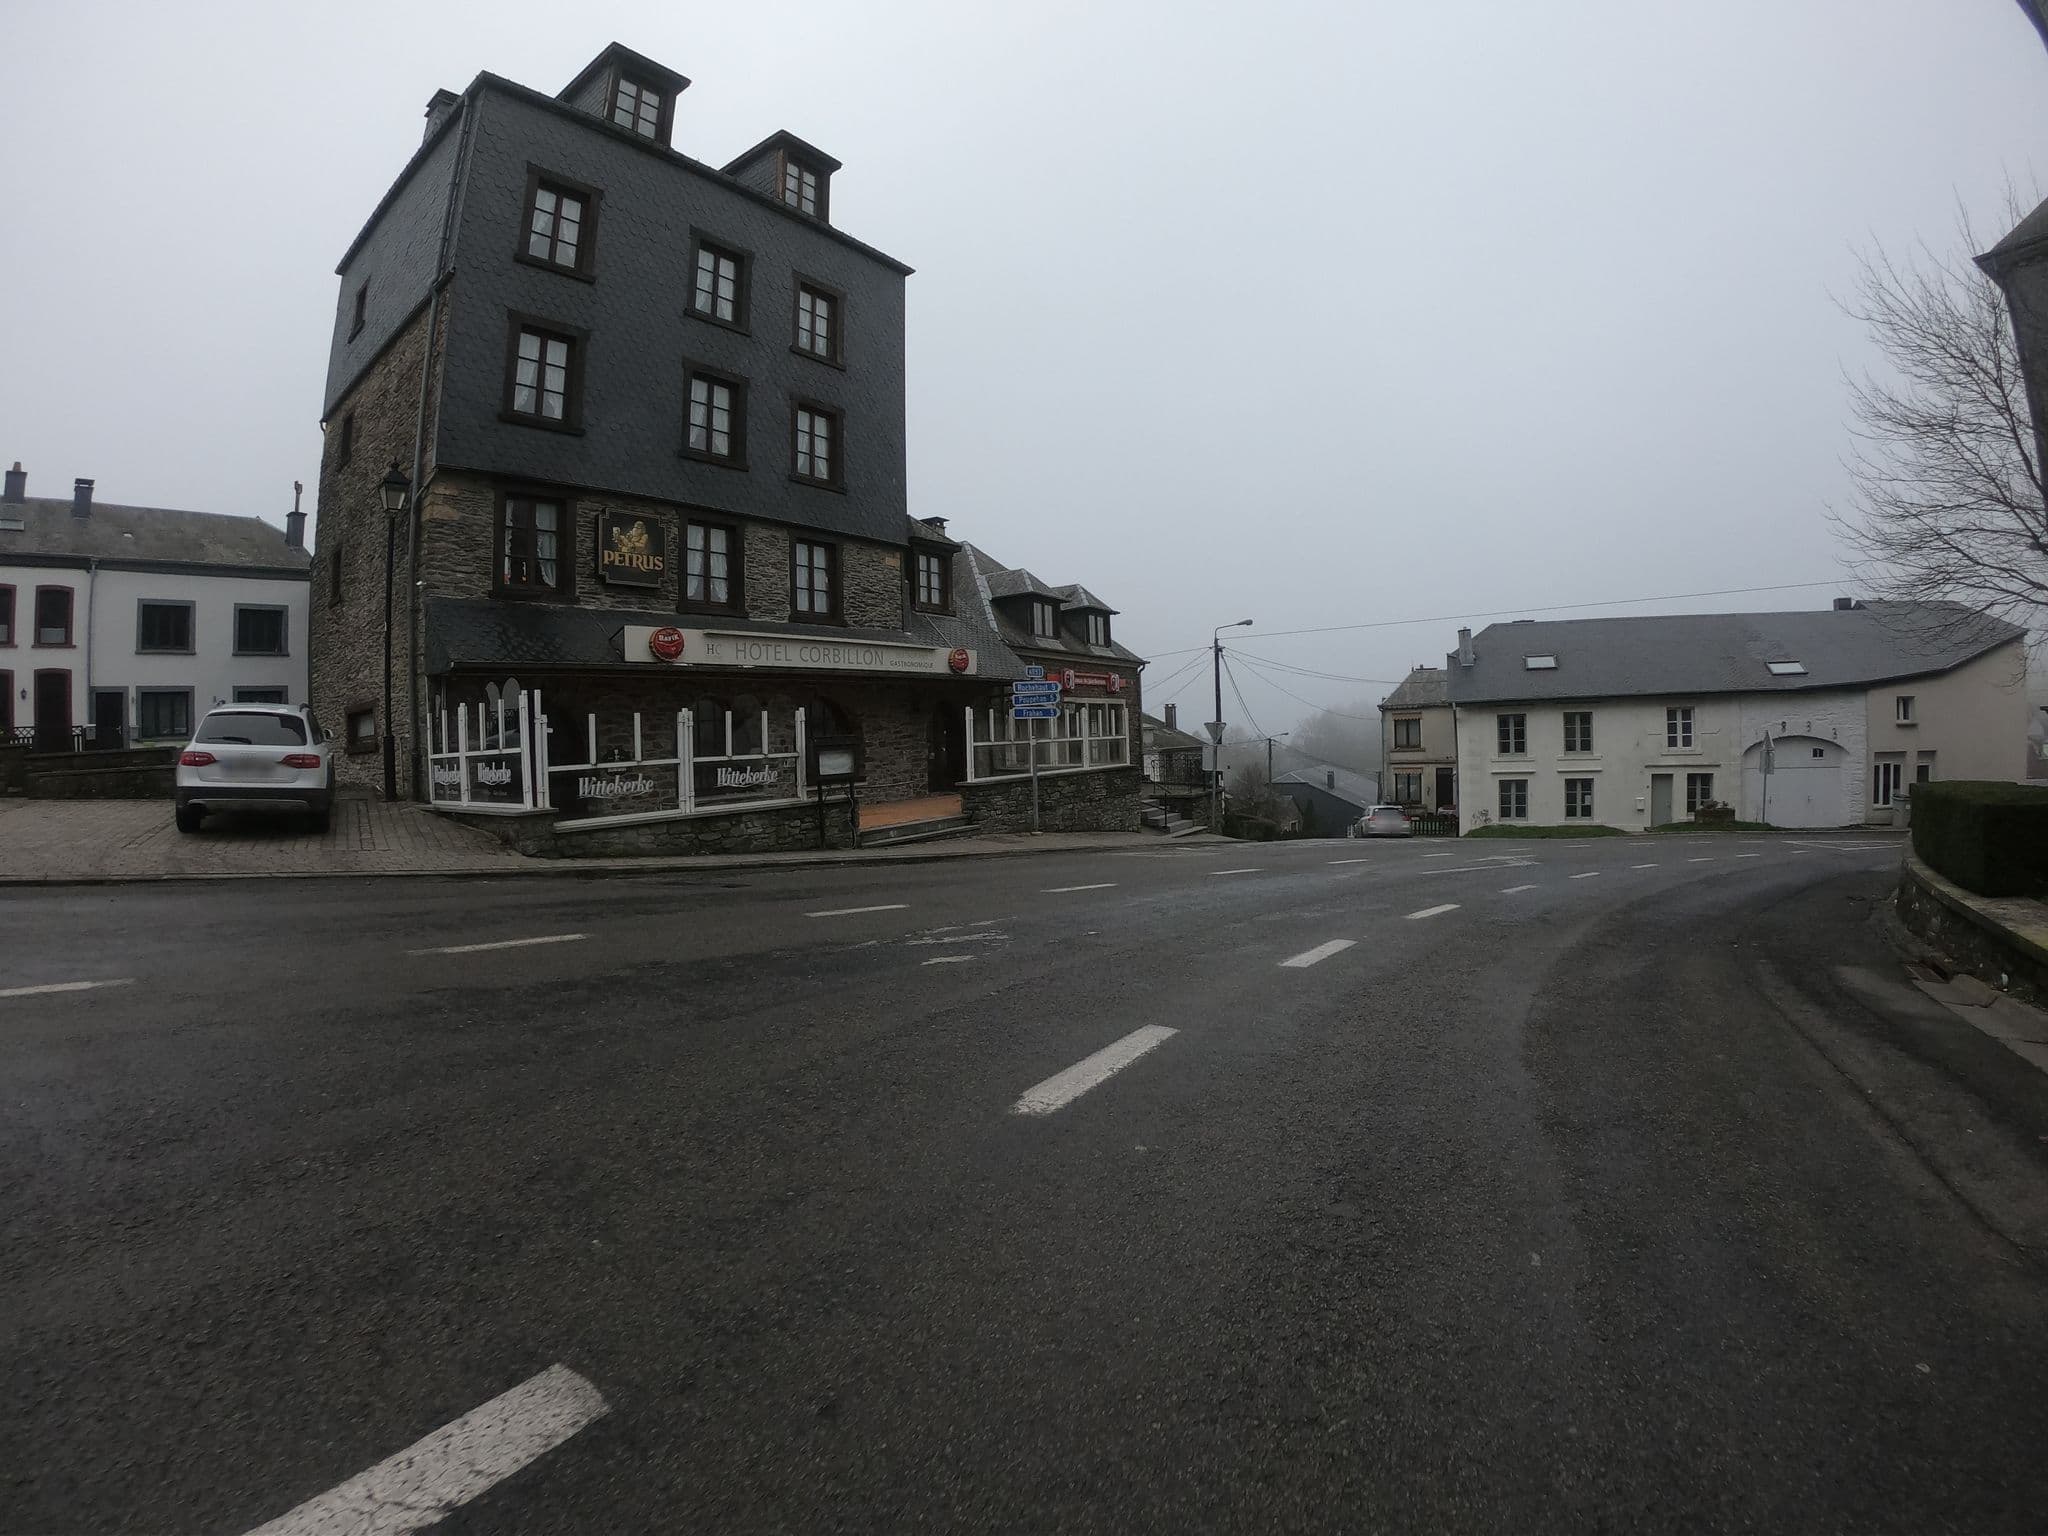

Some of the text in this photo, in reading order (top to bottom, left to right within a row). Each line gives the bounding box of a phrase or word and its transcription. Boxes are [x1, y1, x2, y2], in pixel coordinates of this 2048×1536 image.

[603, 550, 663, 572] PETRUS
[736, 643, 792, 662] HOTEL
[799, 646, 885, 665] CORBILLON
[577, 774, 654, 798] Wittekerke
[716, 765, 778, 787] Wittekerke
